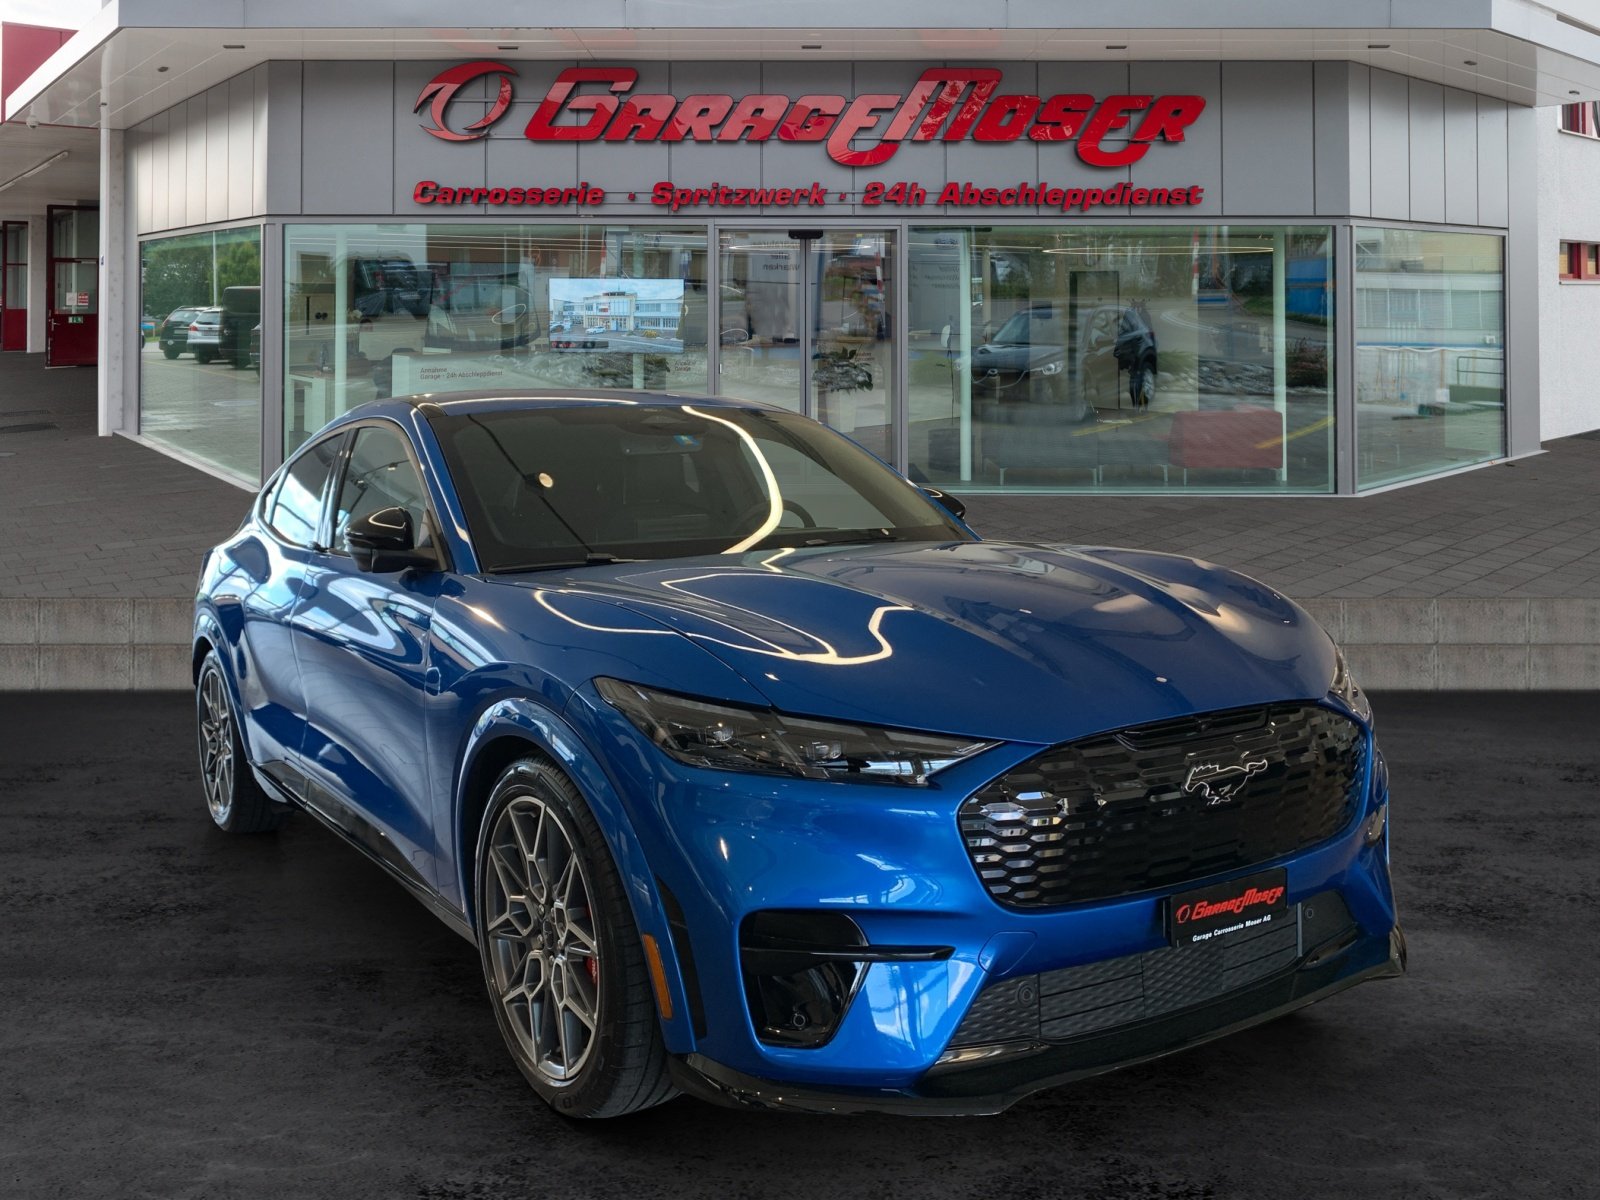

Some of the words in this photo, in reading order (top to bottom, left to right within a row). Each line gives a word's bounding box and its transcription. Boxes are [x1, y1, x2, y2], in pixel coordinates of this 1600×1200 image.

[412, 180, 605, 205] Carrosserie
[650, 181, 827, 212] Spritzwerk
[862, 181, 927, 206] 24h
[937, 181, 1204, 212] Abschleppdienst
[420, 373, 441, 381] Garage
[1192, 931, 1213, 942] Garage
[1213, 923, 1244, 936] Carrosserie
[1245, 918, 1262, 928] Moser
[1262, 914, 1272, 922] AG
